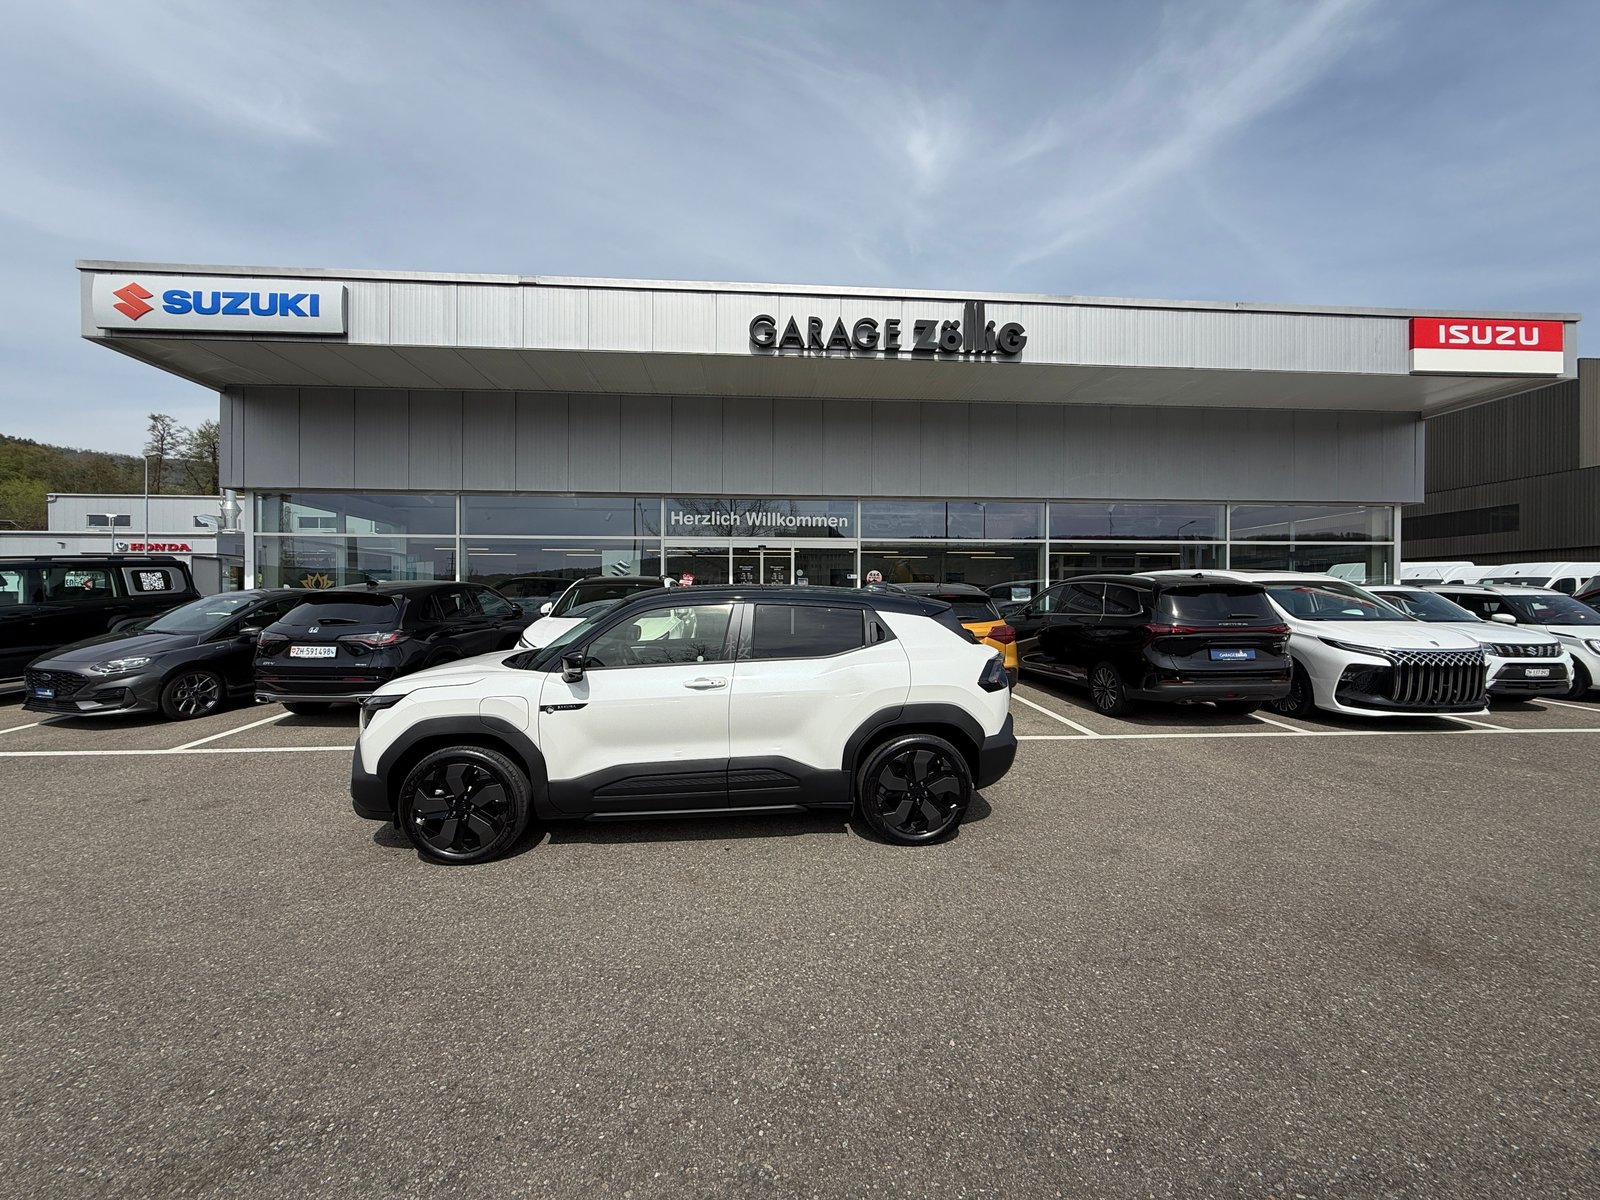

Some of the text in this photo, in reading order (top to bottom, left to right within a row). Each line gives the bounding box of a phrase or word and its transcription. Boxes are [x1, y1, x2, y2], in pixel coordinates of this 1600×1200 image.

[162, 289, 320, 318] SUZUKI
[749, 314, 902, 351] GARAGE
[1438, 324, 1540, 346] ISUZU
[670, 511, 849, 528] Herzlich Willkommen
[130, 543, 192, 552] HONDA
